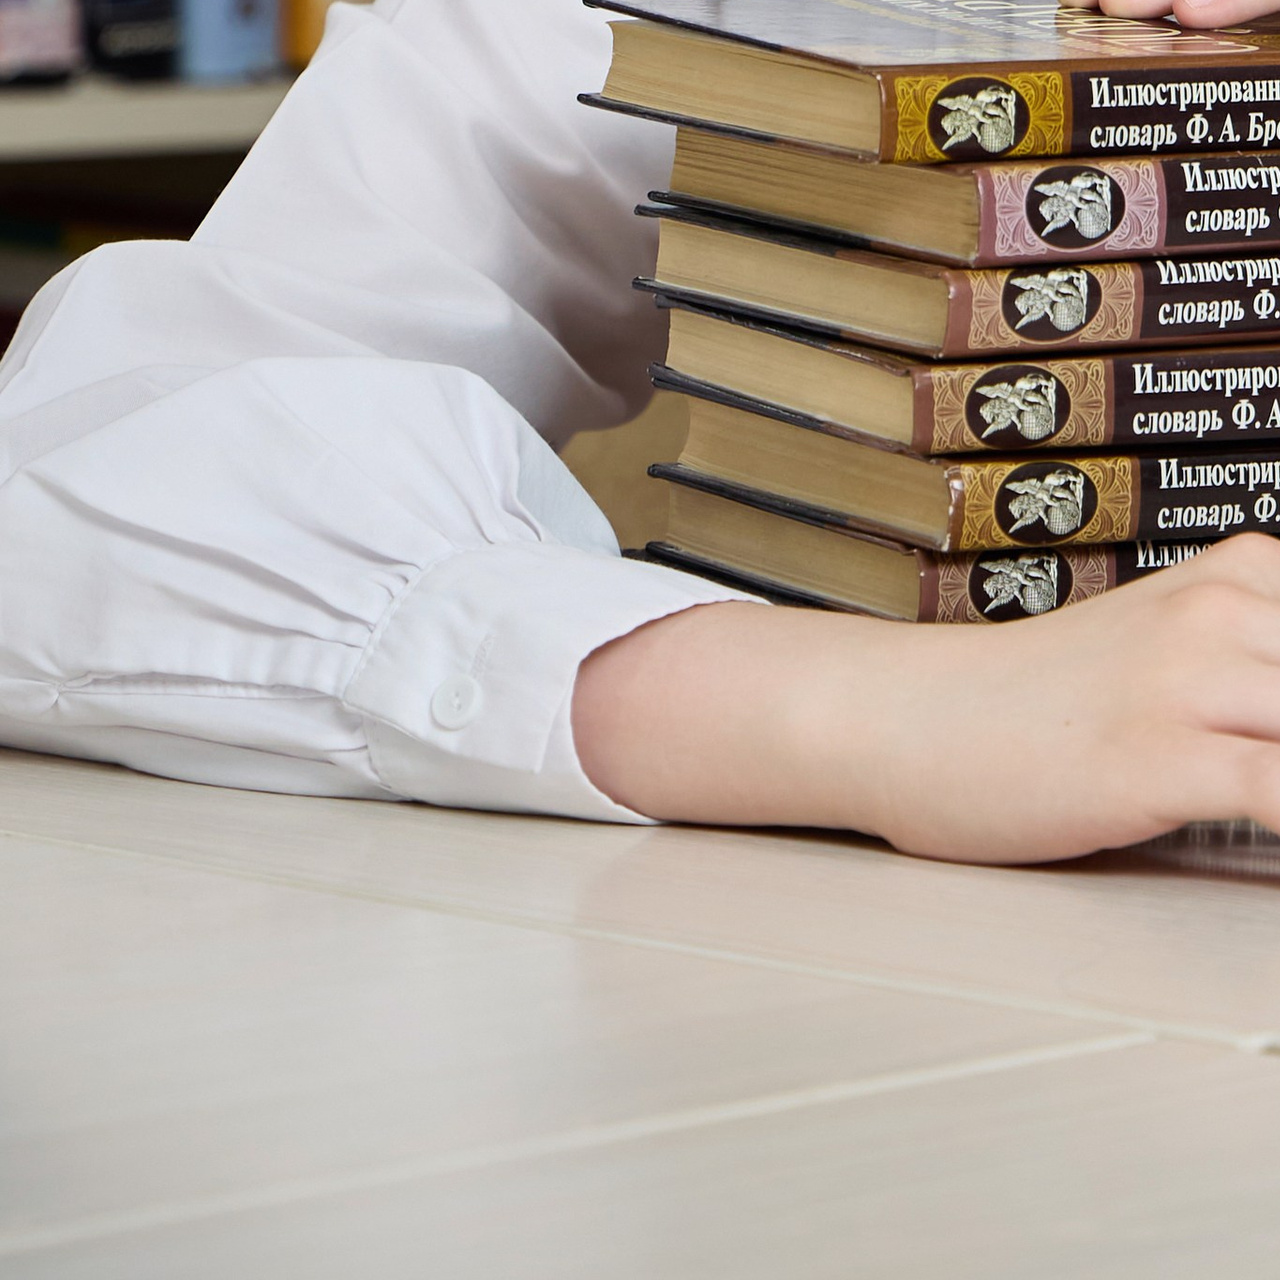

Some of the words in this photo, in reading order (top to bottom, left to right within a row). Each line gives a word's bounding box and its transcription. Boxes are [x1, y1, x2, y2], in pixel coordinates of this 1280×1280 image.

[1090, 123, 1178, 151] словарь
[1186, 113, 1214, 144] Ф.
[1217, 113, 1241, 143] А.
[1185, 207, 1271, 235] словарь
[1158, 299, 1245, 327] словарь
[1253, 288, 1280, 320] Ф.
[1132, 409, 1223, 438] словарь
[1231, 398, 1261, 430] Ф.
[1157, 503, 1245, 530] словарь
[1253, 492, 1280, 523] Ф.
